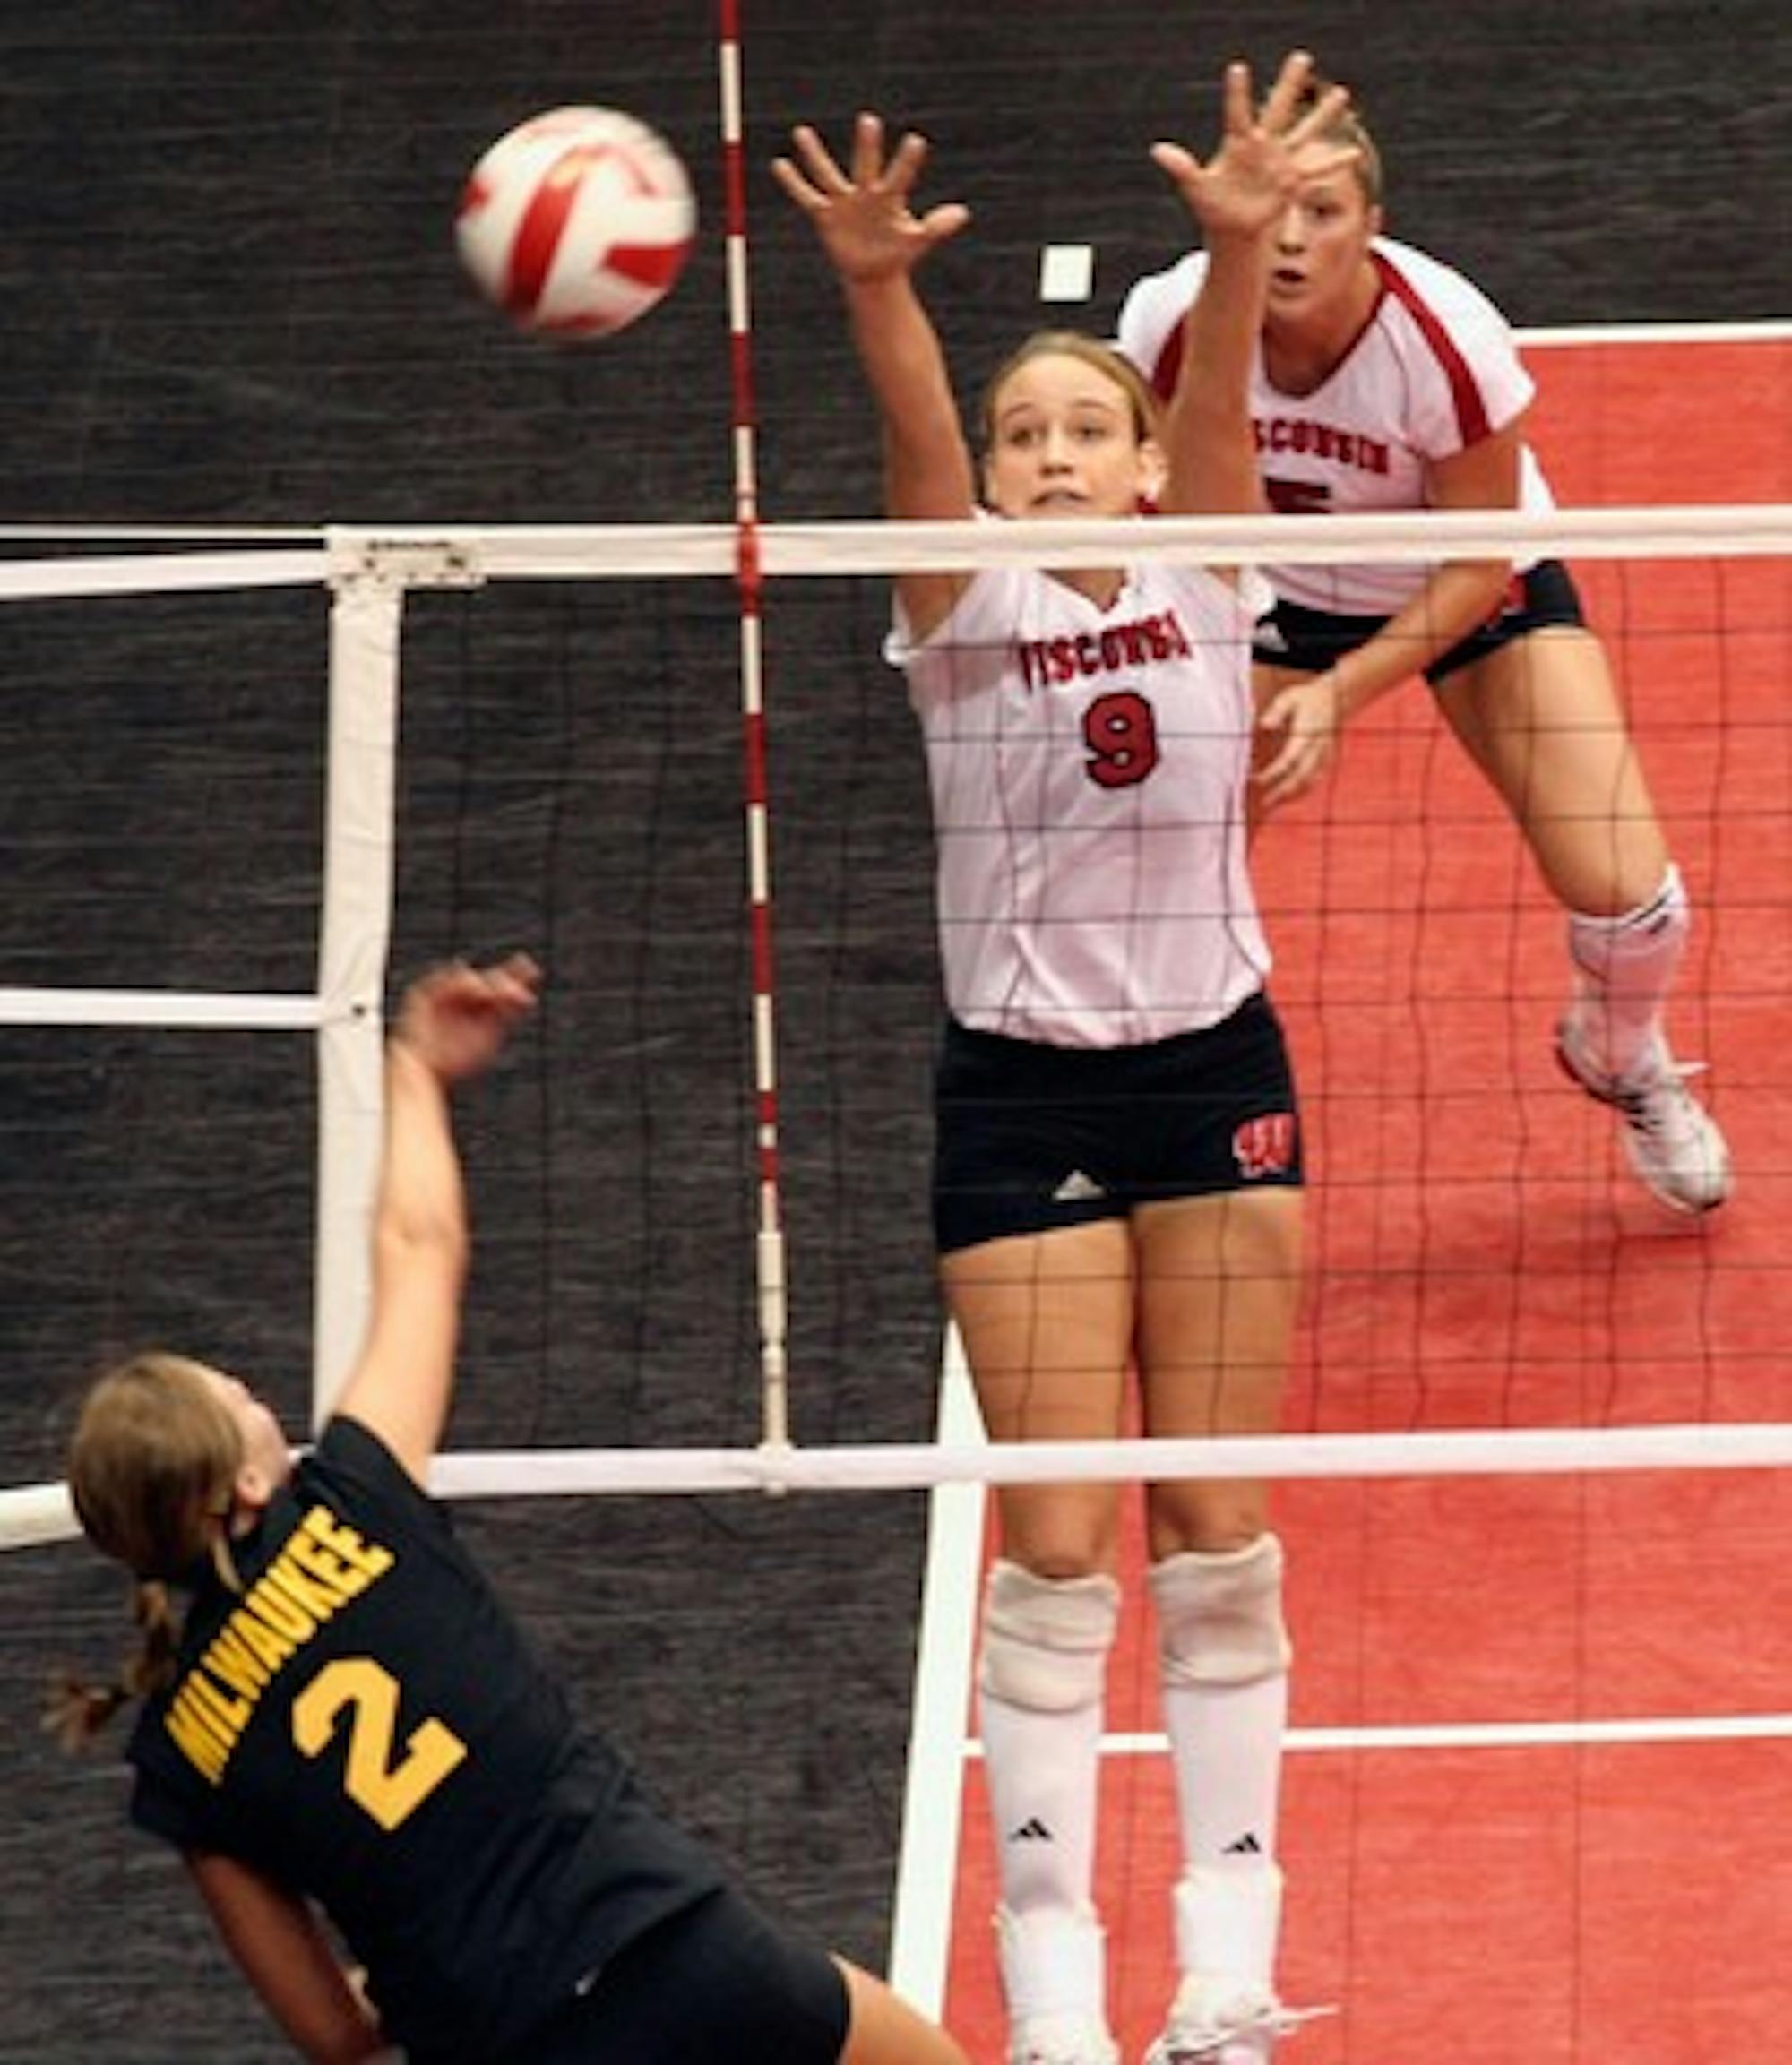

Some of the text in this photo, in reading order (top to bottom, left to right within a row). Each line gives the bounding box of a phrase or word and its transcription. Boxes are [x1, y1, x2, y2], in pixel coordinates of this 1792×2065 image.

[1083, 692, 1159, 788] 9
[164, 1504, 397, 1785] MILWAUKEE
[292, 1658, 468, 1831] 2
